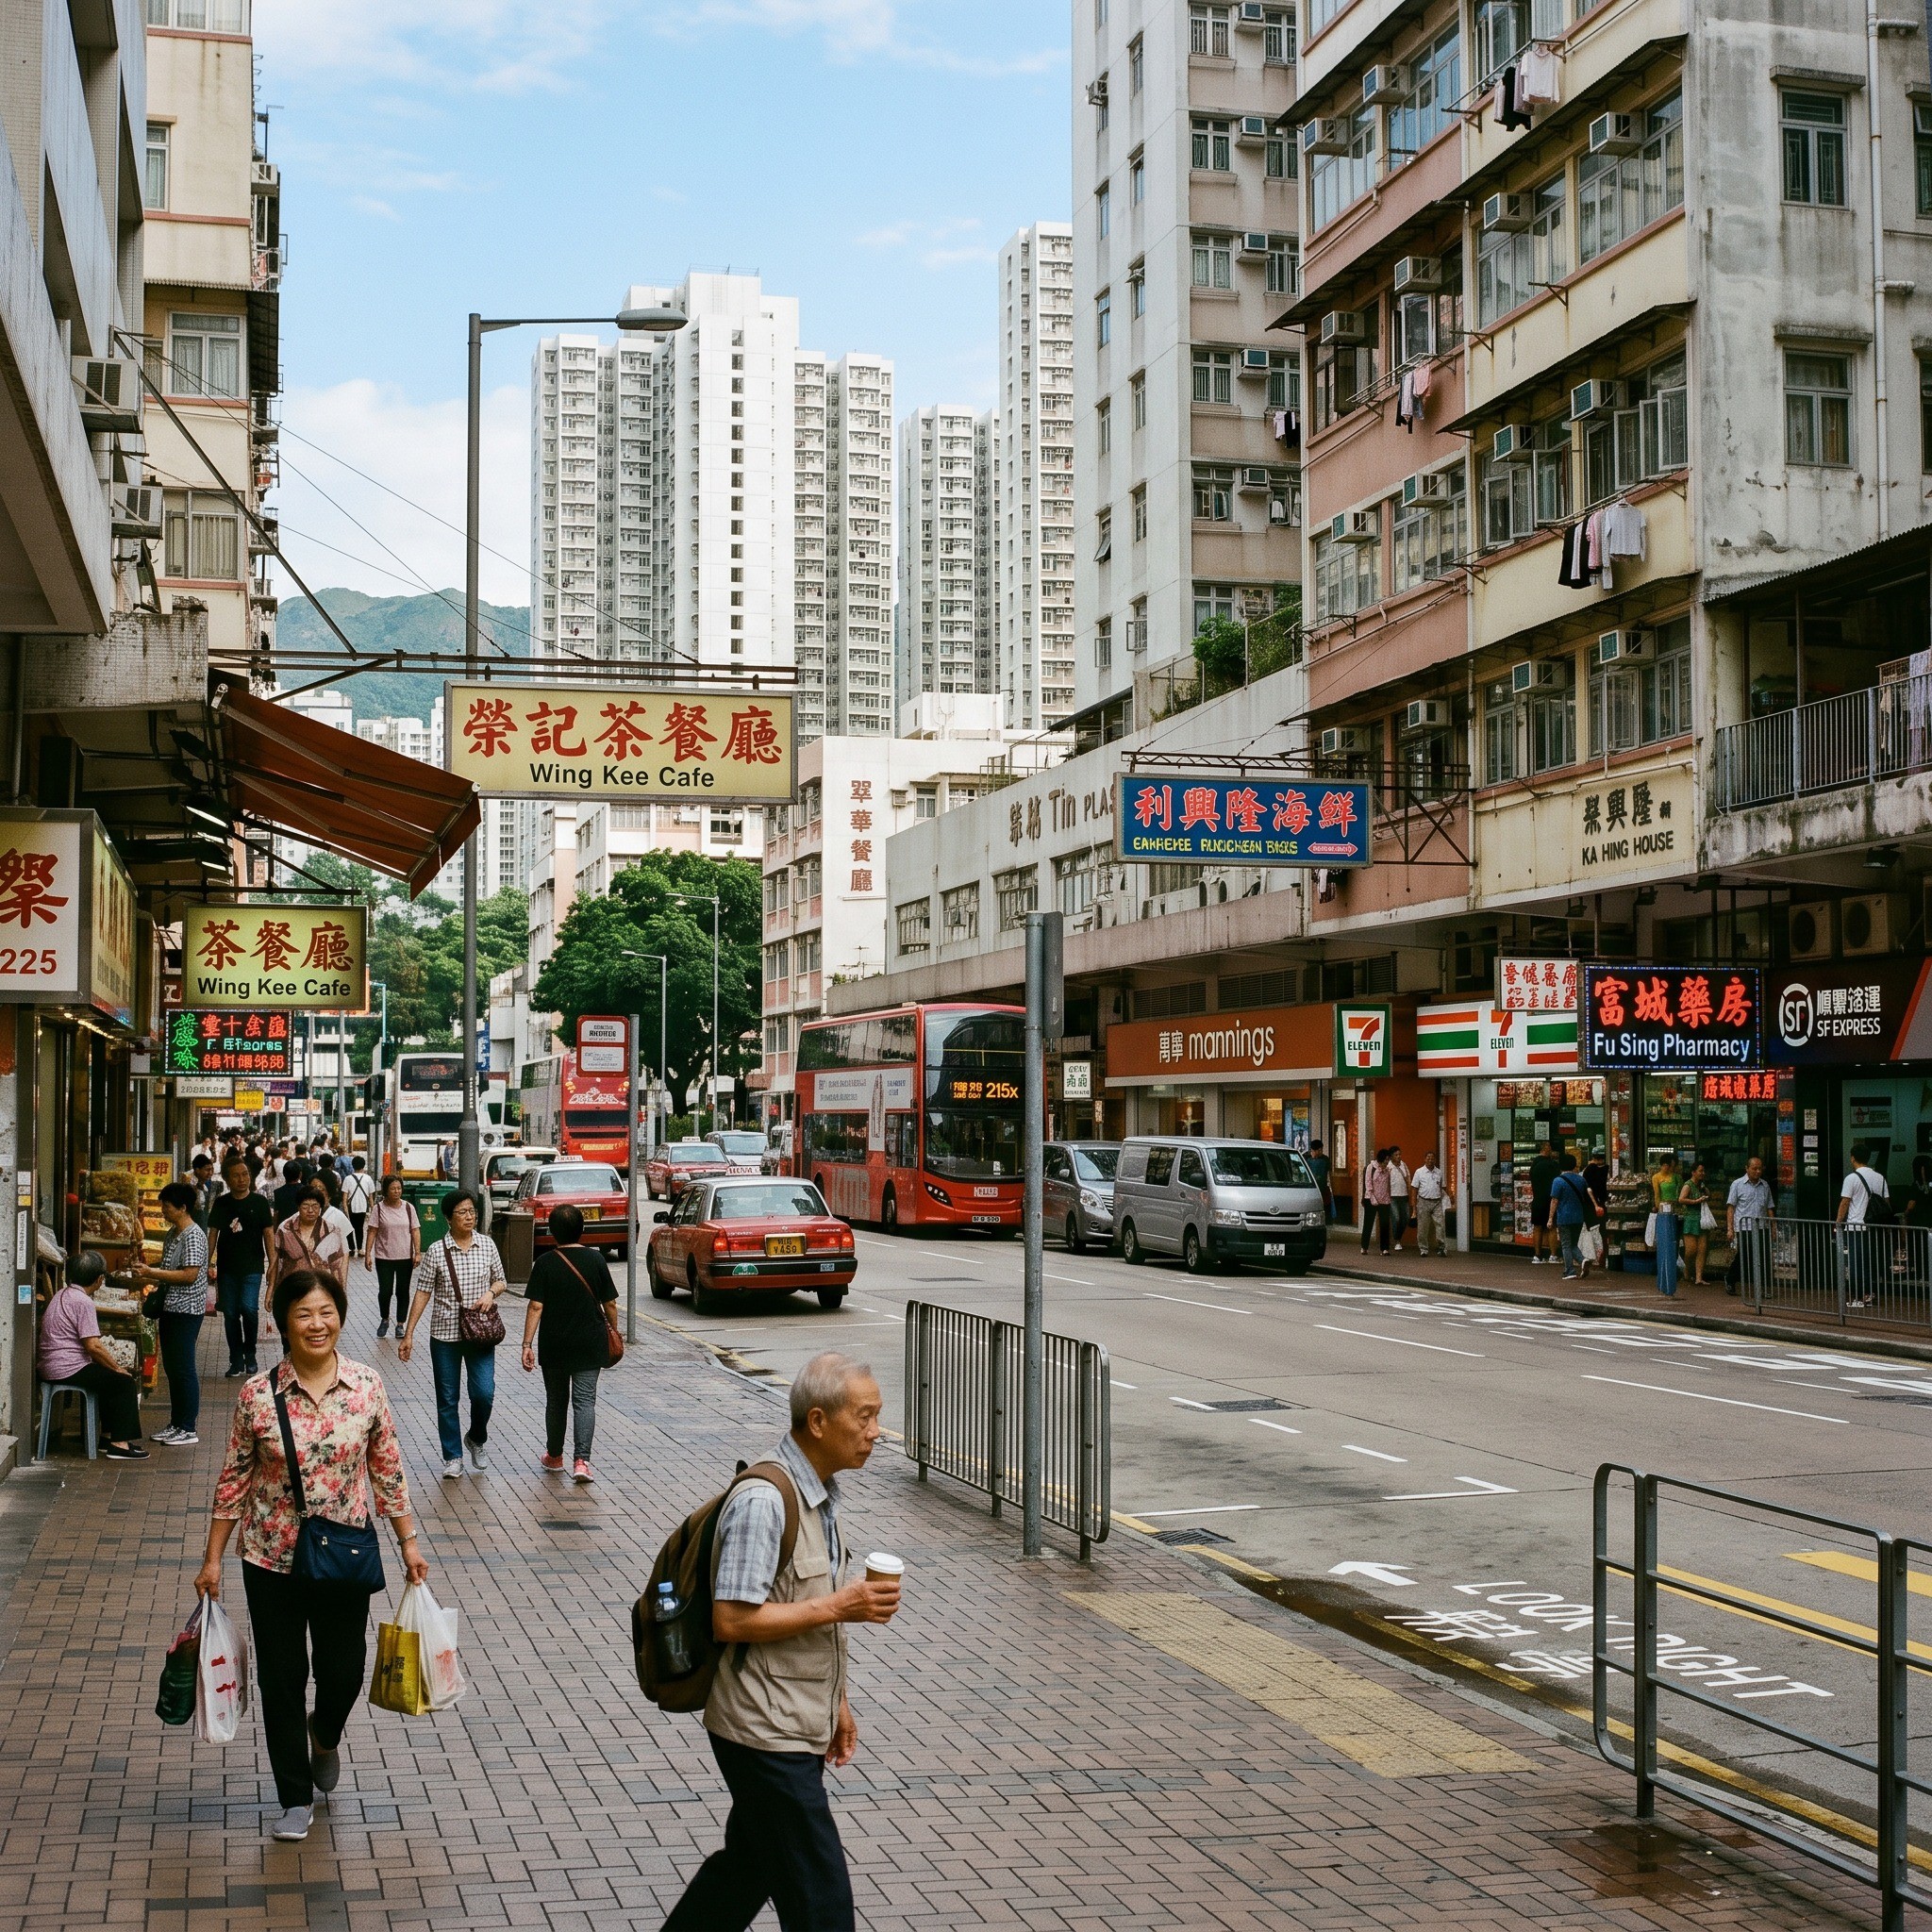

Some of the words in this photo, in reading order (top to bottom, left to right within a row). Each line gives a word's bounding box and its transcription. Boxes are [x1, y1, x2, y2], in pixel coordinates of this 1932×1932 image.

[462, 698, 783, 765] 榮記茶餐廳
[530, 763, 592, 790] Wing
[602, 765, 649, 786] Kee
[658, 765, 715, 788] Cafe
[1048, 782, 1076, 833] Tin
[1134, 784, 1358, 838] 利興隆海鮮
[1582, 846, 1598, 866] KA
[1602, 839, 1629, 862] HING
[1633, 830, 1674, 857] HOUSE
[195, 919, 355, 973] 茶餐廳
[197, 977, 250, 1000] Wing
[258, 977, 297, 995] Kee
[304, 978, 351, 996] Cafe
[1594, 975, 1752, 1028] 富城藥房
[1189, 1019, 1274, 1067] mannings
[1594, 1033, 1616, 1057] Fu
[1621, 1034, 1659, 1062] Sing
[1665, 1034, 1750, 1062] Pharmacy
[1817, 1020, 1831, 1037] SF
[1833, 1017, 1881, 1036] EXPRESS
[1452, 1580, 1636, 1633] LOOK
